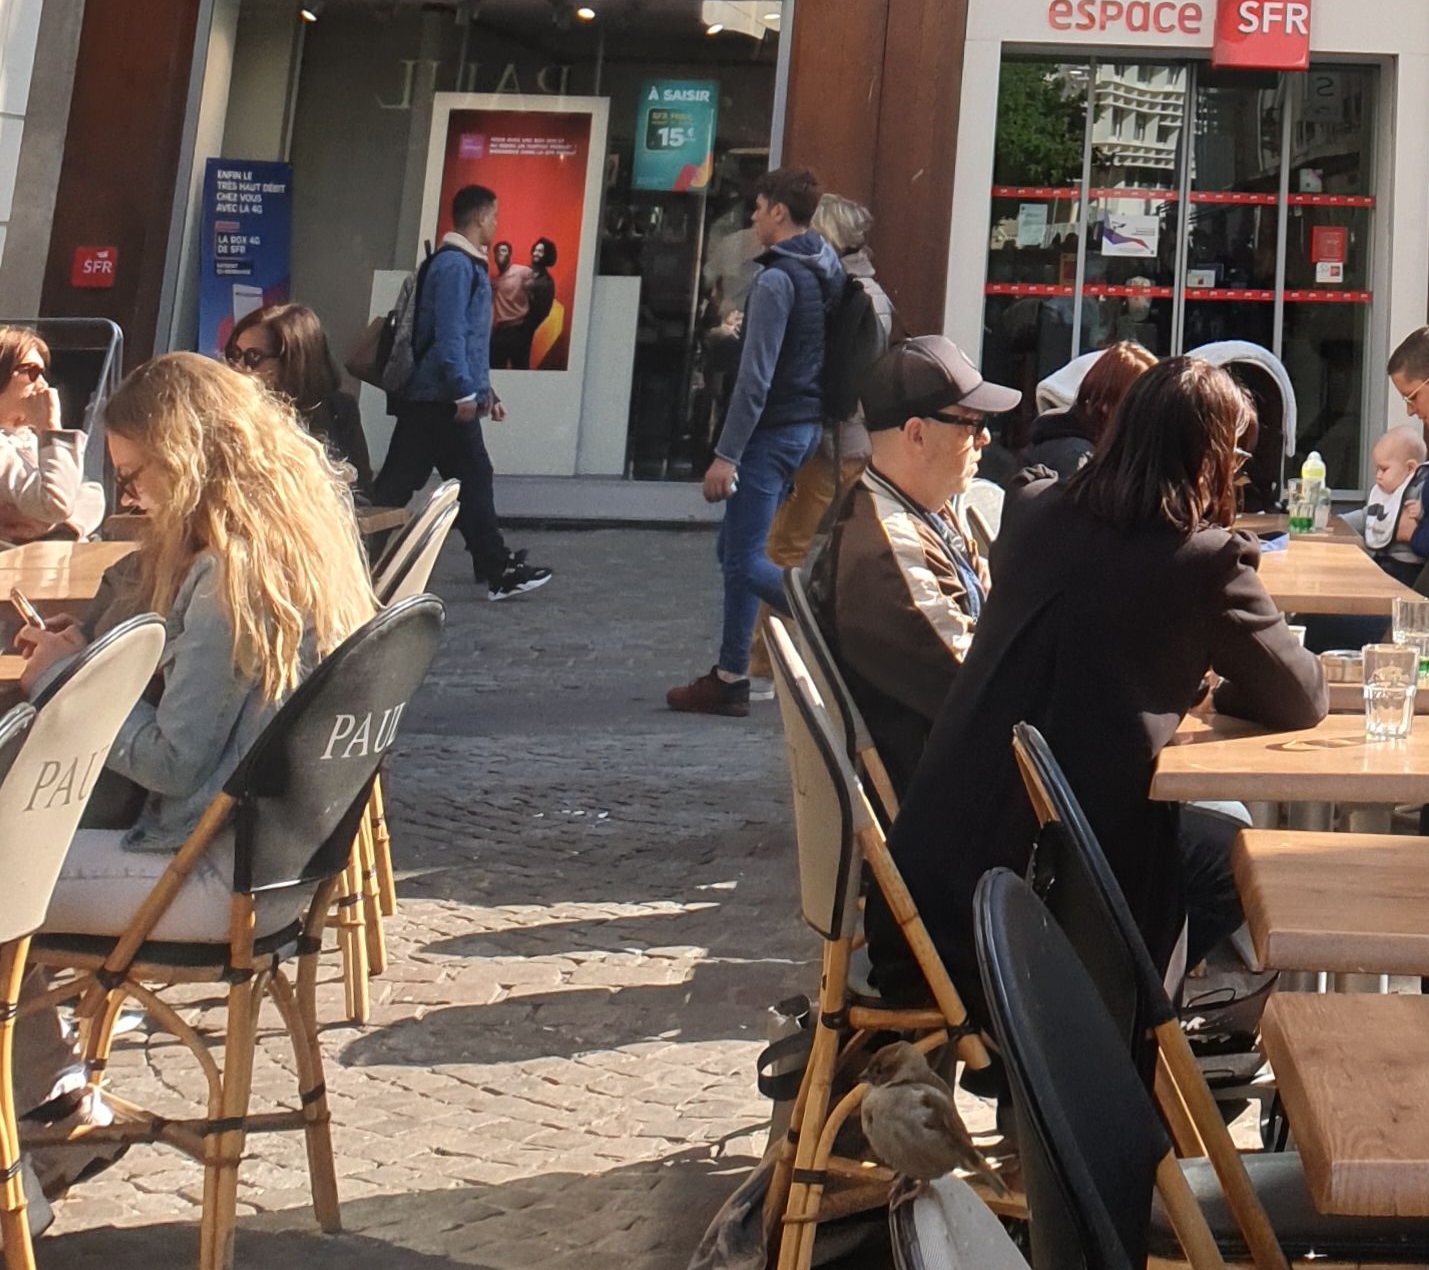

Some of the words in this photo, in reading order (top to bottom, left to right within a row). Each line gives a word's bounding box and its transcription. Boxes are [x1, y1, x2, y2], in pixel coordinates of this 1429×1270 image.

[1237, 0, 1310, 36] SFR
[663, 88, 711, 102] SAISIR
[217, 170, 241, 180] ENFIN
[243, 172, 254, 181] LE
[239, 183, 262, 192] HAUT
[216, 192, 238, 202] CHEZ
[240, 194, 263, 203] VOUS
[215, 203, 238, 213] AVEC
[240, 205, 250, 214] LA
[217, 236, 229, 245] LA
[217, 245, 228, 254] DE
[83, 259, 113, 274] SFR
